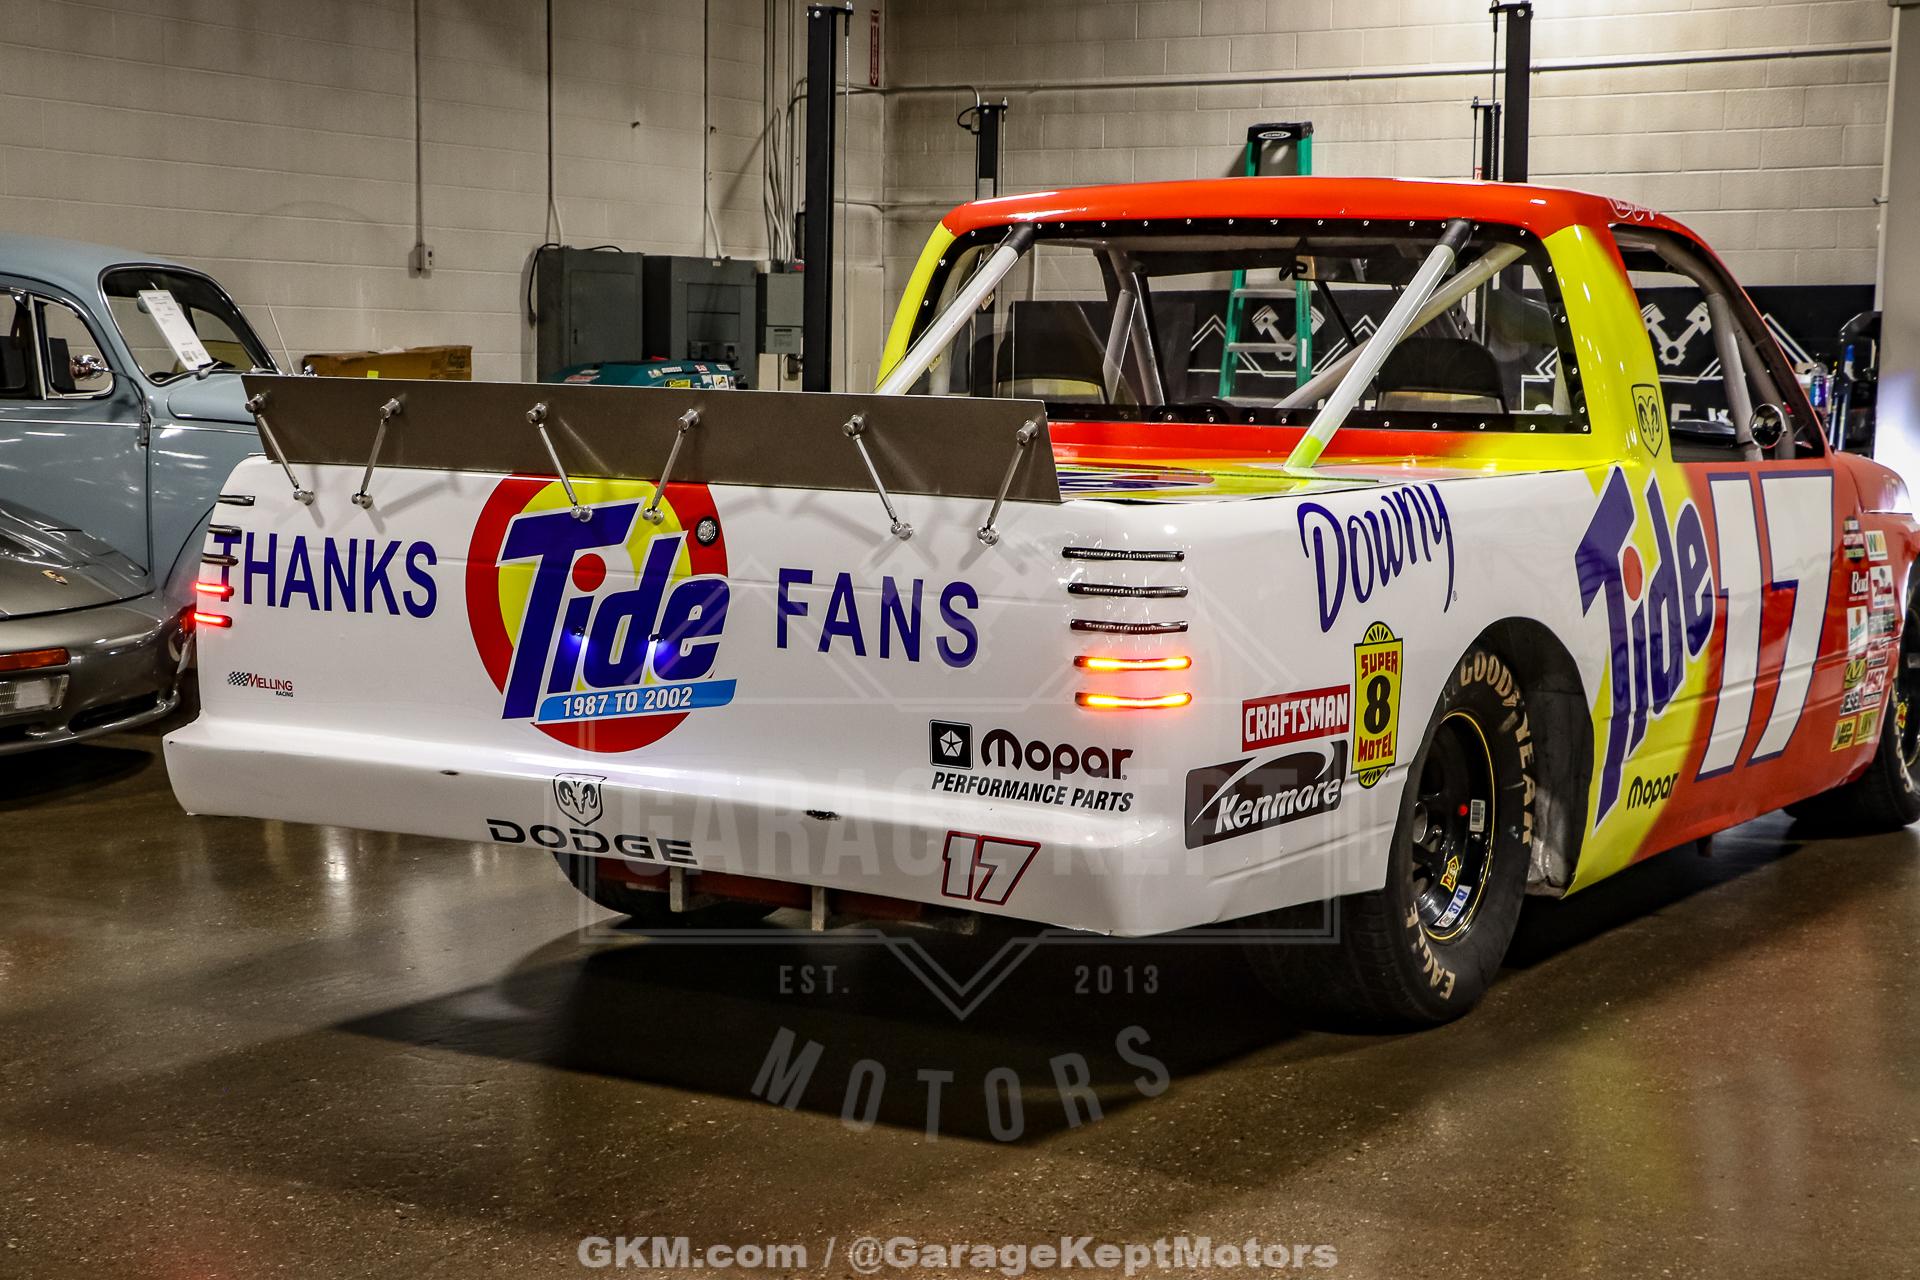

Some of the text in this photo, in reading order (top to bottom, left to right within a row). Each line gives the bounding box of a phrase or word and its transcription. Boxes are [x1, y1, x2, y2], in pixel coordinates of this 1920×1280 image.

[1297, 483, 1455, 633] Downy
[214, 501, 980, 720] THANKS Tide FANS
[1695, 469, 1834, 783] 17
[1361, 651, 1398, 679] SUPER
[1574, 466, 1713, 830] Tide
[246, 672, 294, 691] MELLING
[562, 686, 693, 717] 1987 TO 2002
[1363, 675, 1392, 735] 8
[1245, 692, 1348, 744] CRAFTSMAN
[981, 729, 1134, 780] Mopar
[1357, 731, 1394, 763] MOTEL
[931, 771, 1134, 812] PERFORMANCE PARTS
[1215, 777, 1342, 835] Kenmore
[1626, 771, 1680, 811] Mopar
[486, 818, 698, 865] DODGE
[941, 830, 1041, 905] 17
